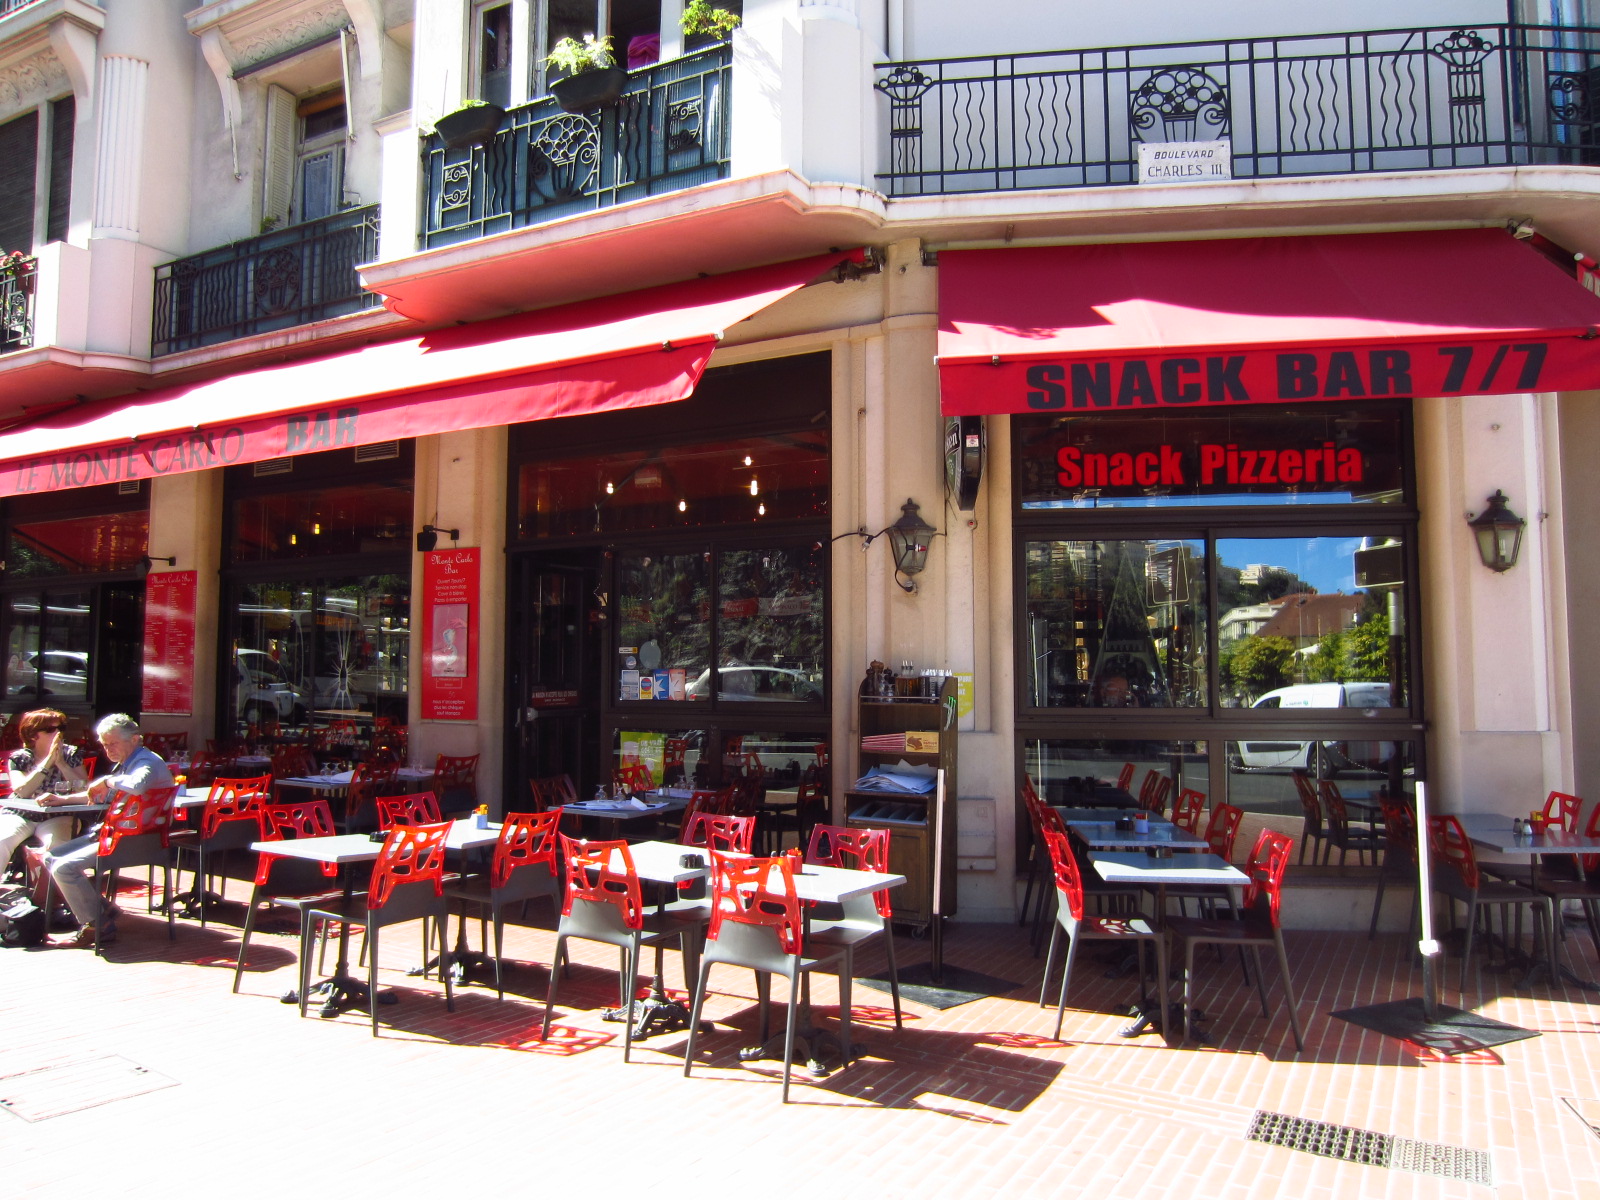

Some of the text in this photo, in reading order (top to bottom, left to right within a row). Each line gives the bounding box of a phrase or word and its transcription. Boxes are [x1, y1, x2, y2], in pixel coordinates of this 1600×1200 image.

[1154, 150, 1214, 160] BOULEVARD
[1148, 164, 1222, 178] CHARLES III
[1026, 343, 1548, 410] SNACK BAR 7/7
[16, 407, 360, 492] LE MONTE CARLO BAR
[1056, 441, 1363, 487] Snack Pizzeria
[431, 553, 473, 565] Monte Carlo
[444, 564, 458, 574] Bar
